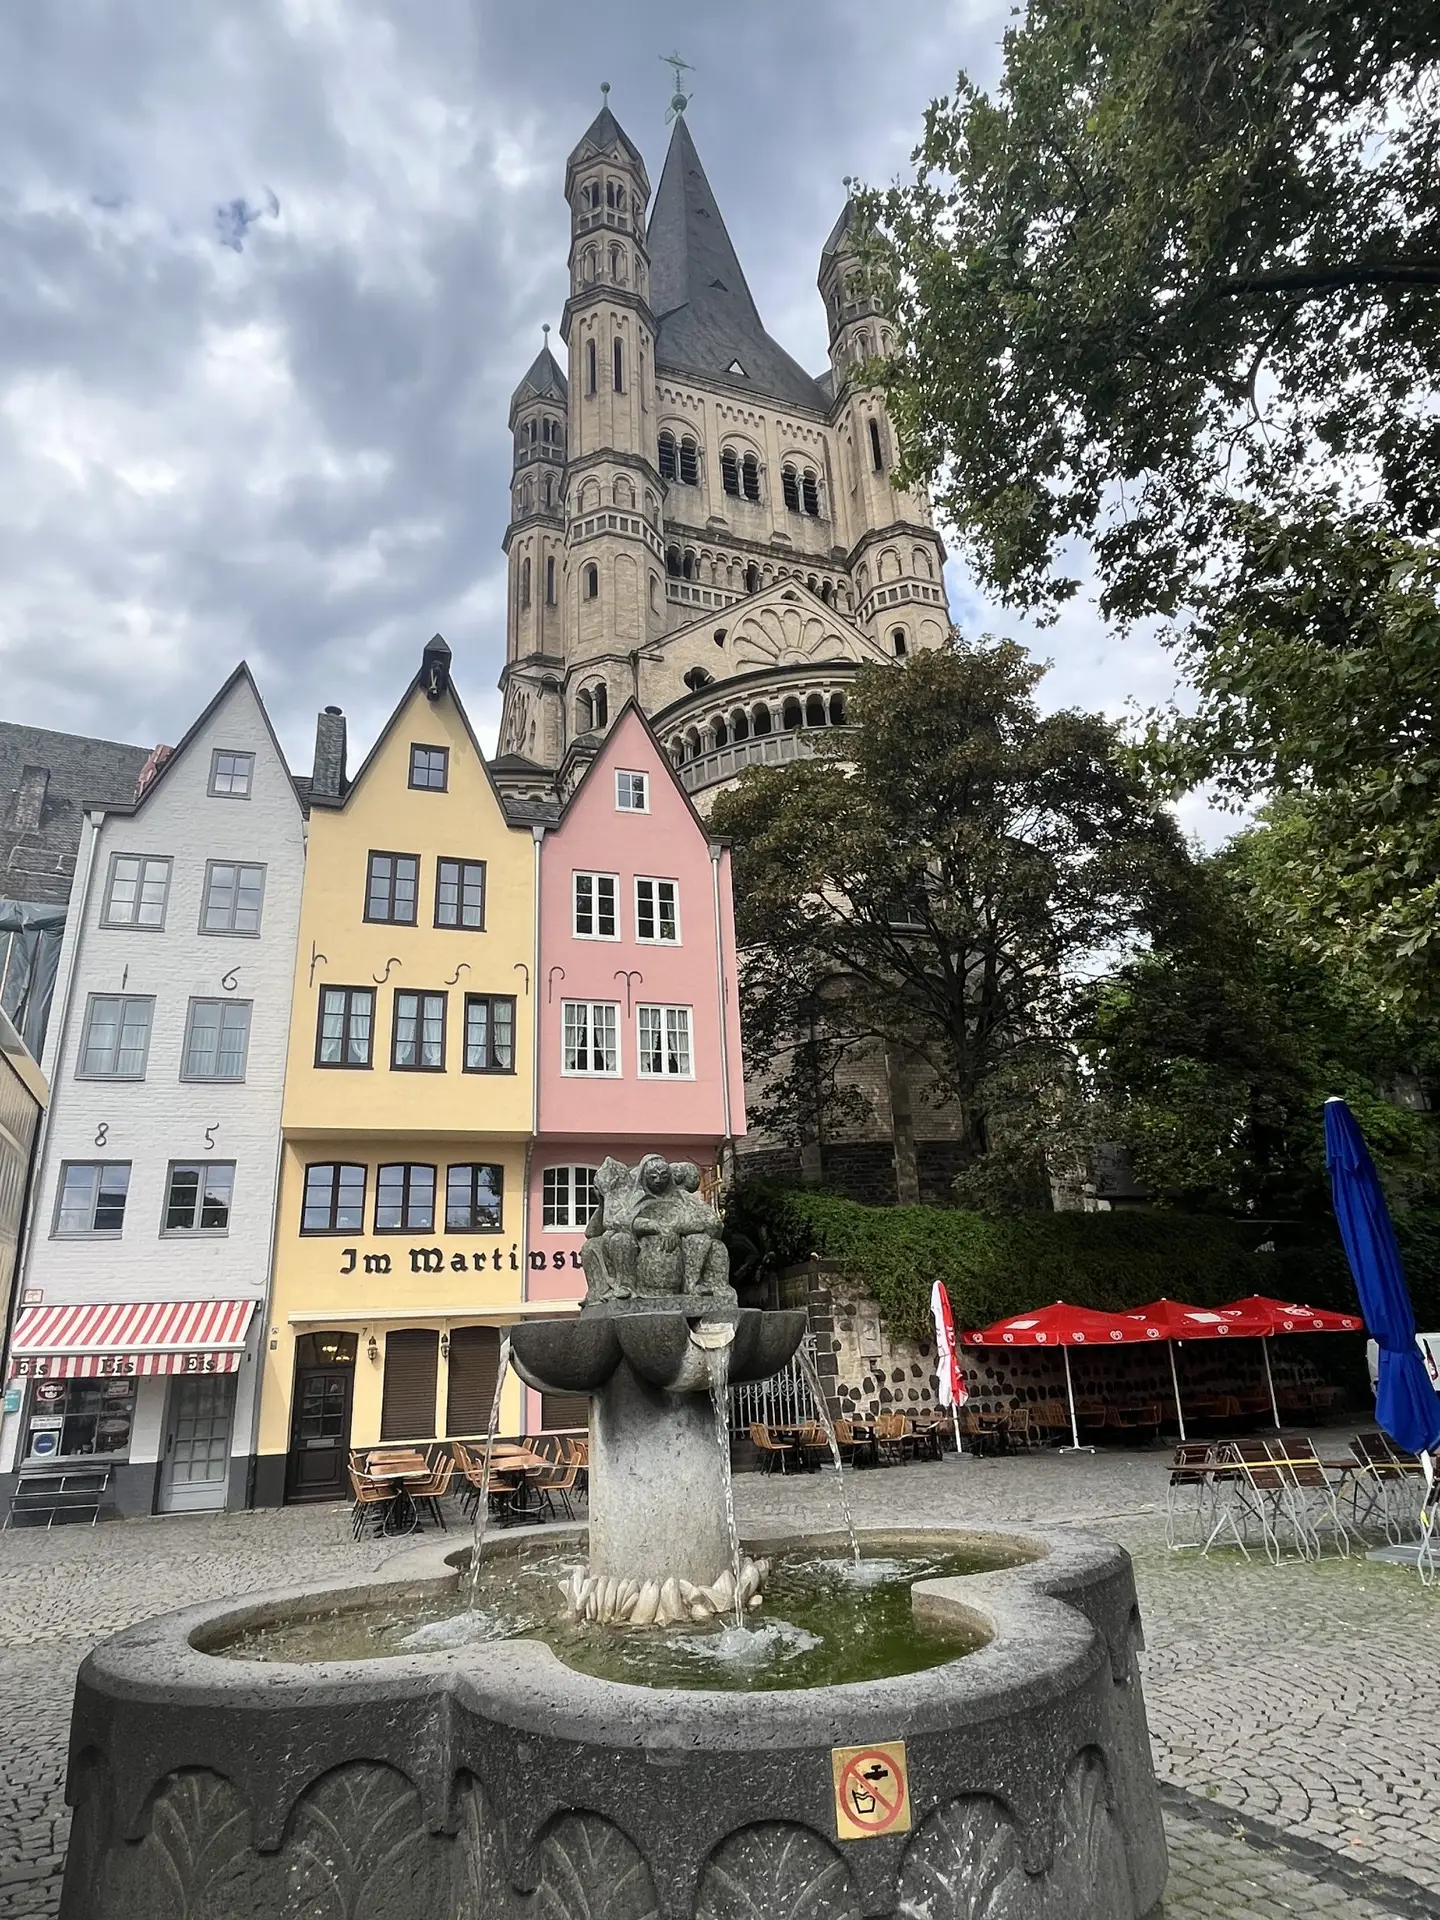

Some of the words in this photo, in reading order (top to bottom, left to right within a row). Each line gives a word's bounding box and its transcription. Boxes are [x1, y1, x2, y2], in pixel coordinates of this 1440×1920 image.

[222, 966, 241, 991] 6
[95, 1122, 109, 1147] 8
[203, 1122, 220, 1150] 5
[340, 1248, 392, 1275] Im
[361, 1327, 368, 1337] 7
[16, 1359, 49, 1376] Eis
[100, 1358, 134, 1374] Eis
[183, 1355, 216, 1372] Eis
